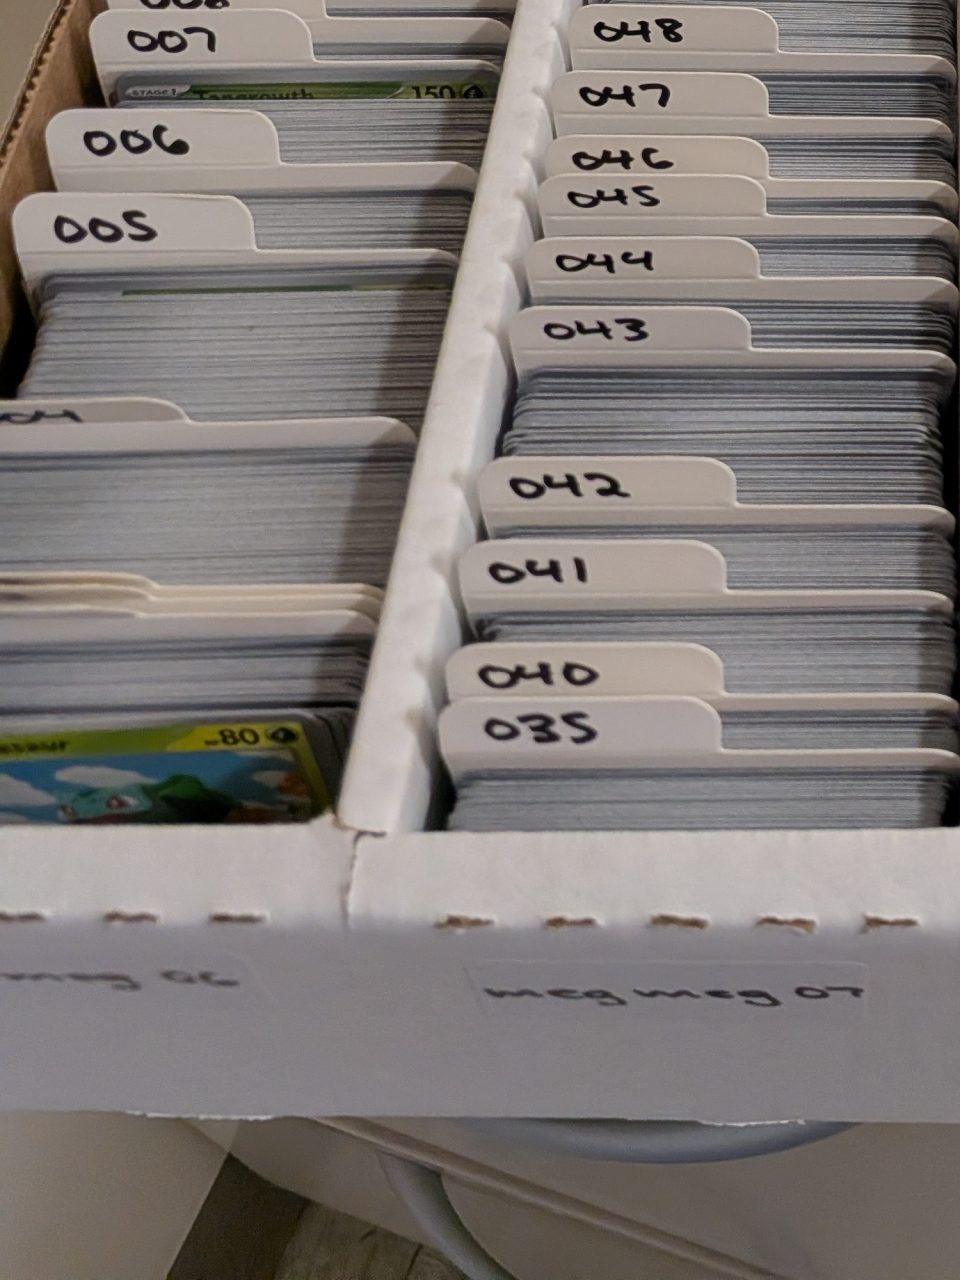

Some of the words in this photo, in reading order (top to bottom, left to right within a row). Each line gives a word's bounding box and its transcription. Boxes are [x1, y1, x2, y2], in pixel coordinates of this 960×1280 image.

[127, 27, 215, 52] 007
[593, 18, 684, 43] 048
[579, 82, 671, 108] 047
[83, 124, 190, 156] 006
[572, 147, 674, 170] 046
[567, 185, 661, 208] 045
[54, 210, 158, 243] 005
[555, 250, 655, 274] 044
[543, 318, 650, 342] 043
[509, 472, 631, 499] 042
[488, 557, 589, 584] 041
[478, 661, 600, 689] 040
[484, 711, 598, 744] 035
